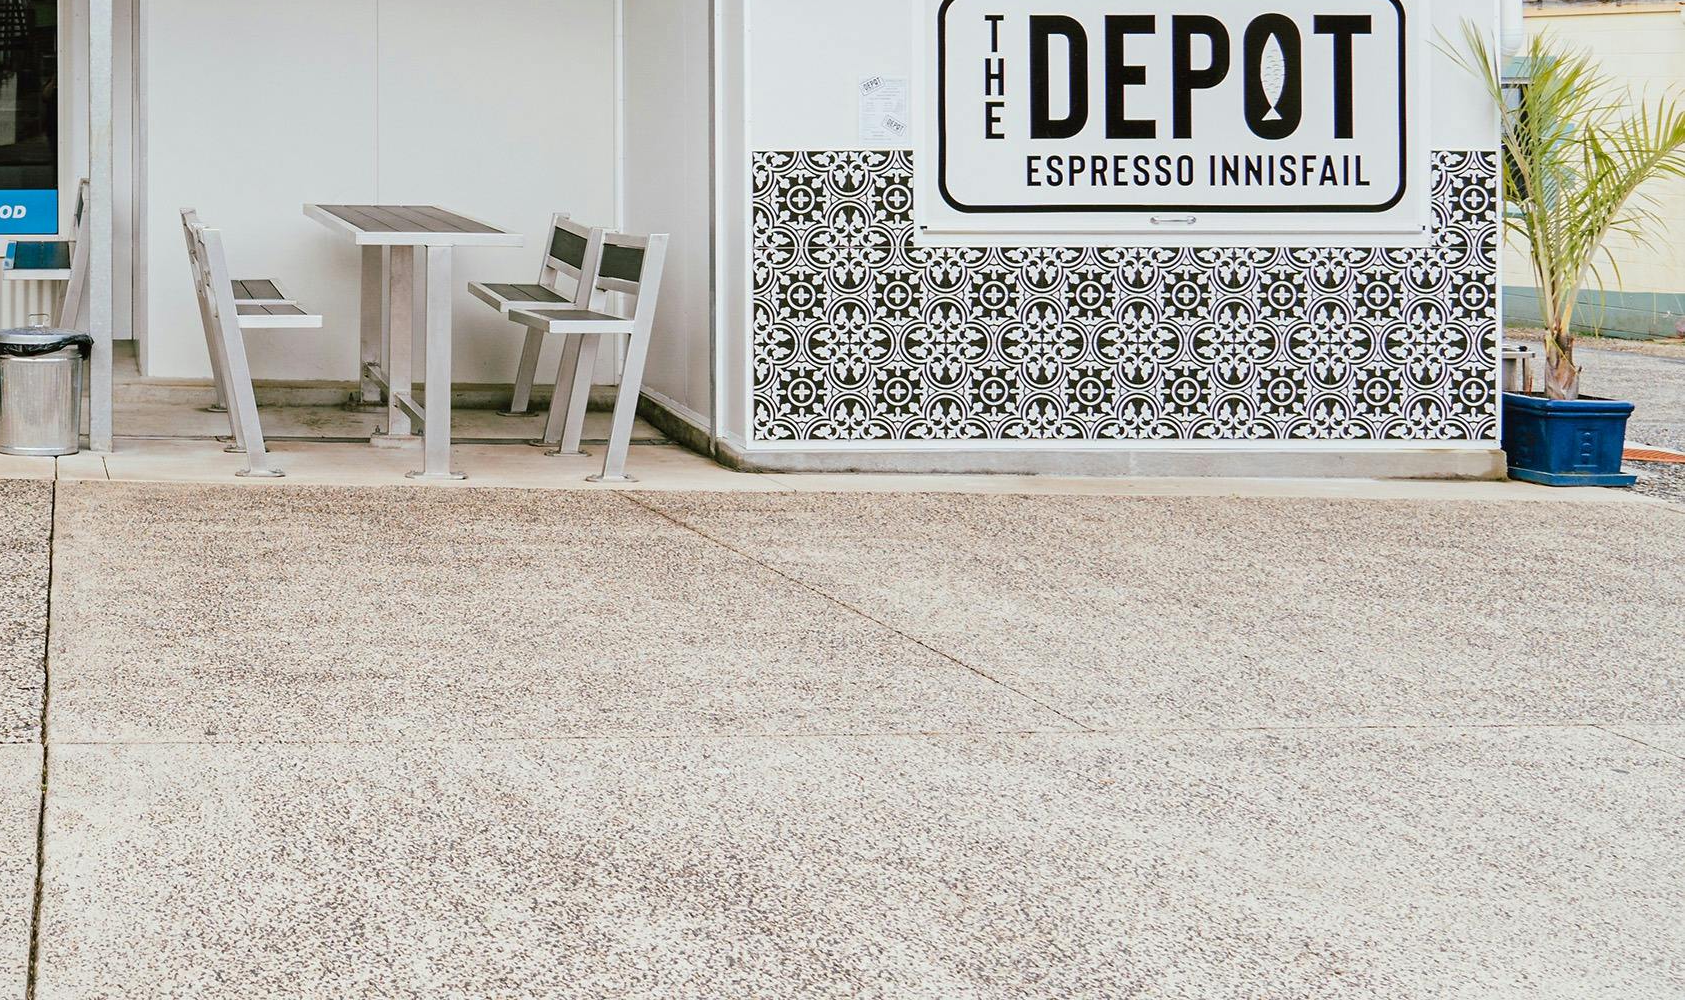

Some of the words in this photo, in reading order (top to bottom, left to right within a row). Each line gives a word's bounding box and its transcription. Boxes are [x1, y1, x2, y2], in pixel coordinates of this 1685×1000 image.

[983, 14, 1006, 140] THE
[1029, 12, 1374, 141] DEPOT
[1026, 153, 1194, 188] ESPRESSO
[1208, 153, 1371, 188] INNISFAIL
